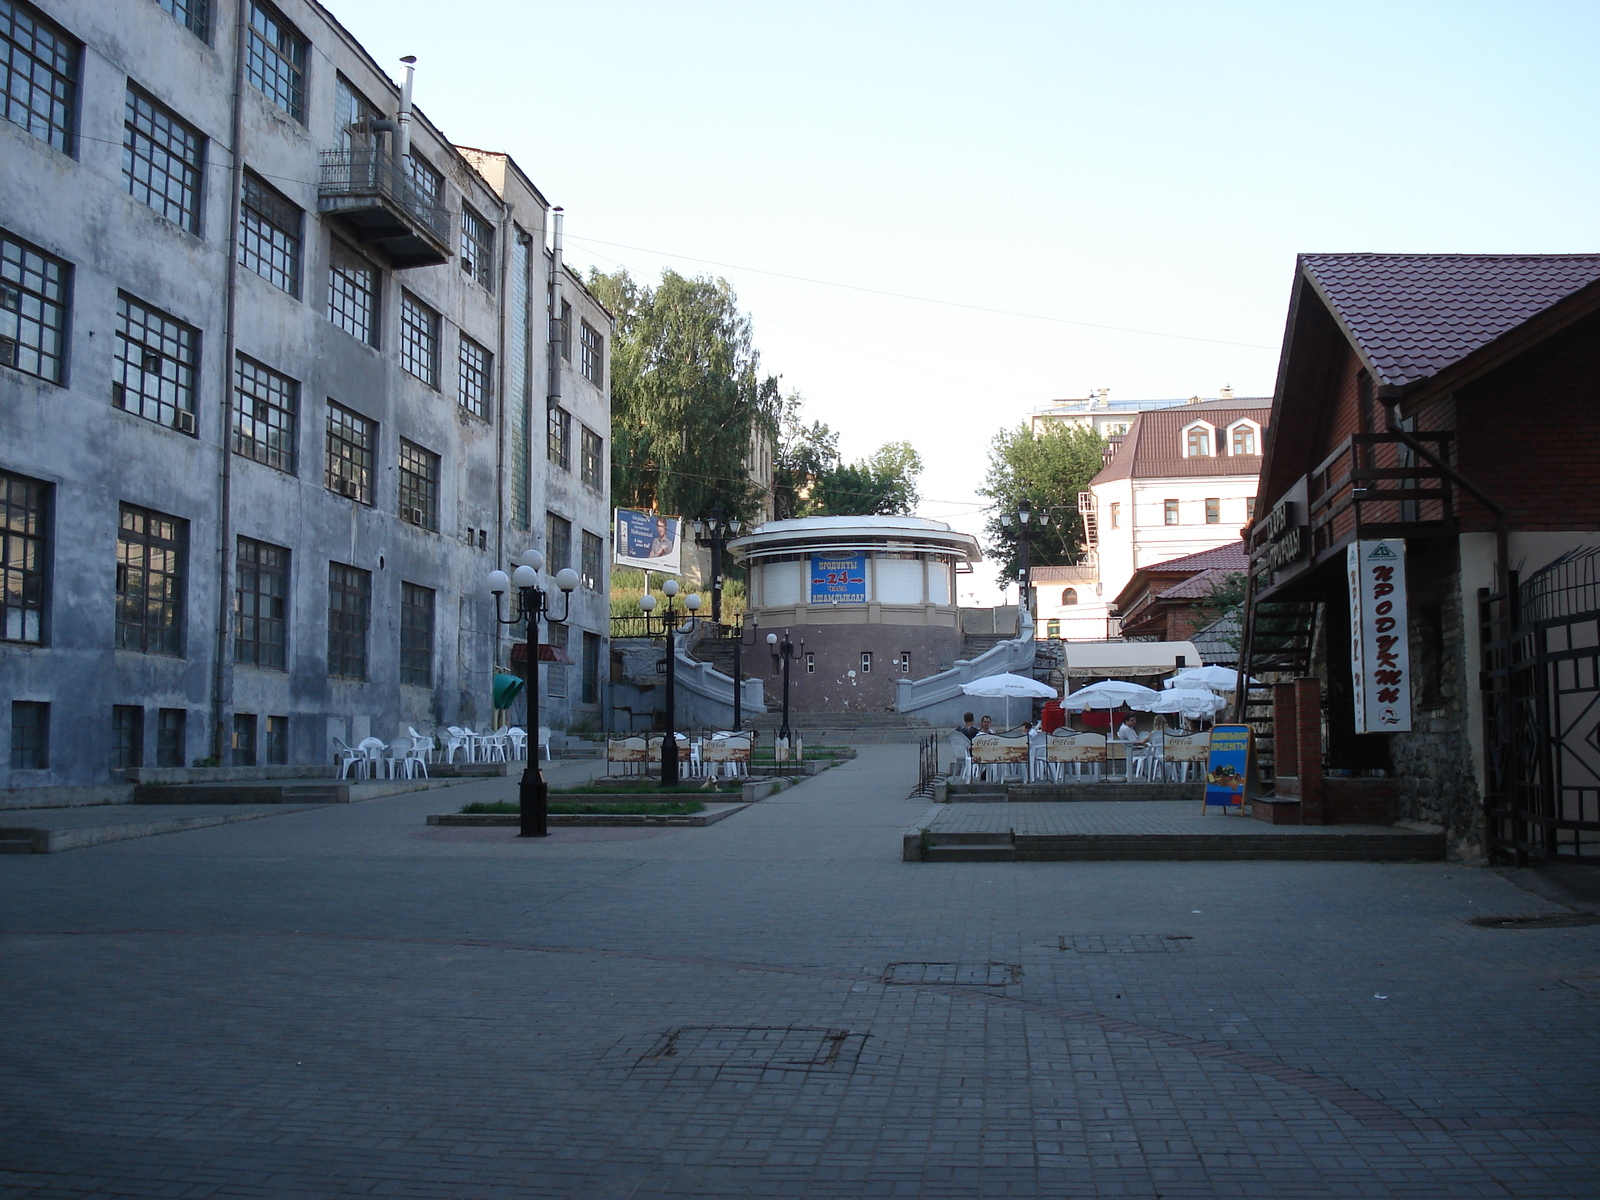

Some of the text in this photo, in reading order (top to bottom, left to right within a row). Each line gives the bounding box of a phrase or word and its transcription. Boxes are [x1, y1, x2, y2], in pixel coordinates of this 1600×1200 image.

[818, 561, 858, 570] ПРОДУКТЫ
[826, 570, 849, 584] 24
[1210, 742, 1248, 751] ПРОДУКТЫ
